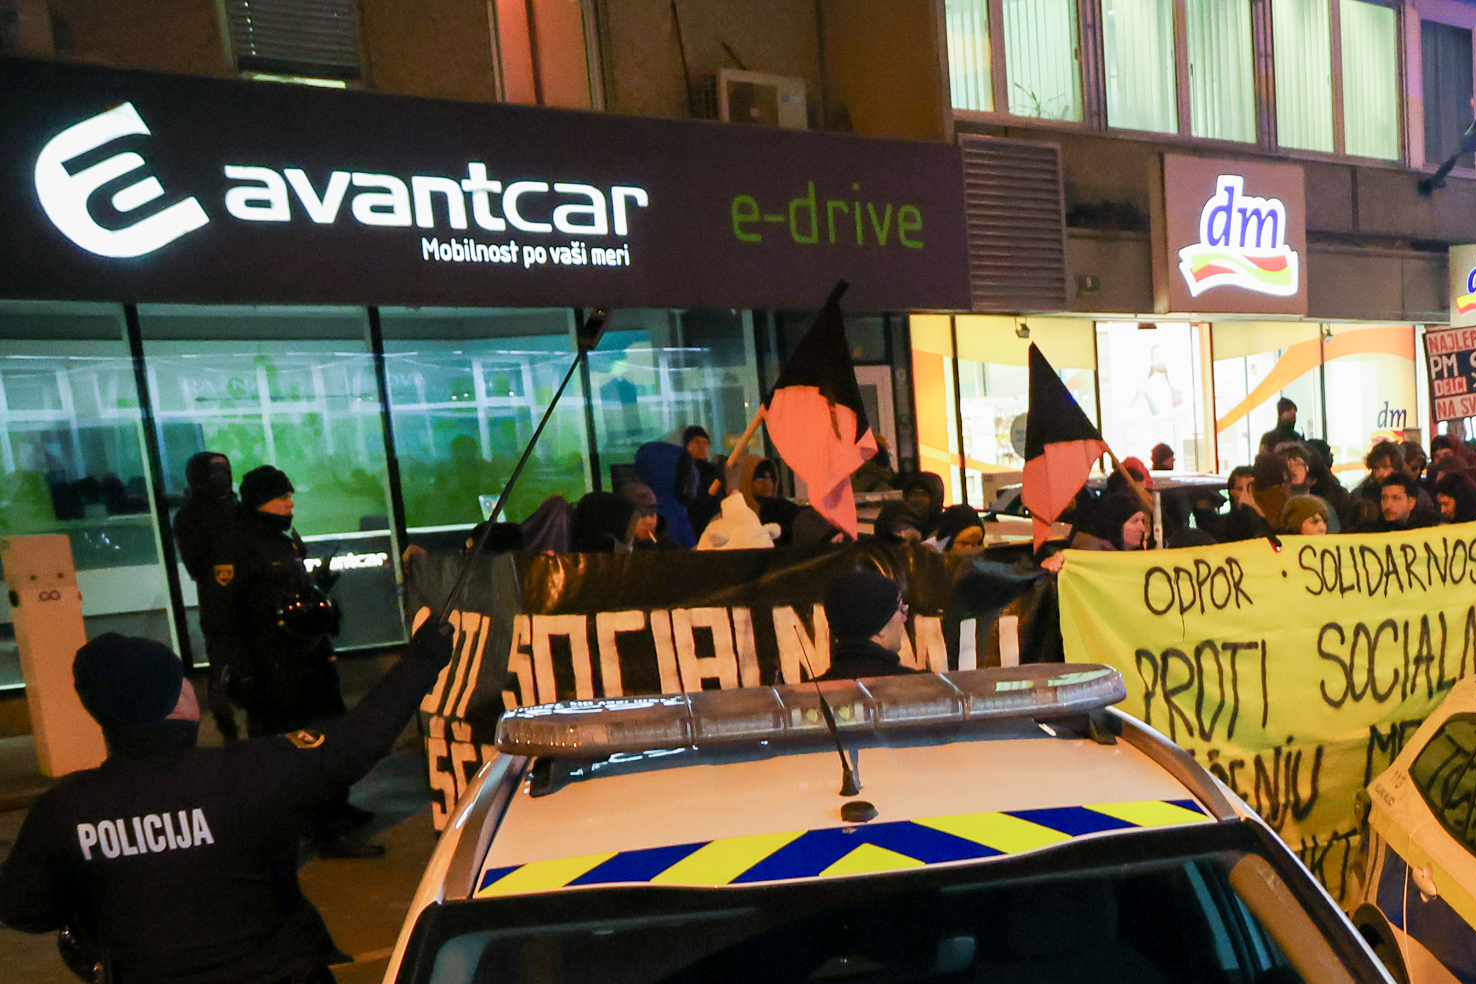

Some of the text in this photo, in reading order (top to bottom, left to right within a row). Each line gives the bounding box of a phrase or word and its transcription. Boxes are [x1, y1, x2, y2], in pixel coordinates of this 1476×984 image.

[224, 162, 649, 236] avantcar
[730, 182, 924, 249] e-drive
[1207, 187, 1281, 249] dm
[421, 237, 630, 269] Mobilnost po vaši meri
[1430, 353, 1458, 379] PM
[1434, 376, 1467, 396] DELCI
[1377, 401, 1406, 428] dm
[1437, 399, 1456, 417] NA
[1144, 558, 1253, 615] ODPOR
[502, 605, 1018, 706] SOCIALNMU
[1134, 639, 1268, 743] PROTI
[77, 808, 215, 861] POLICIJA
